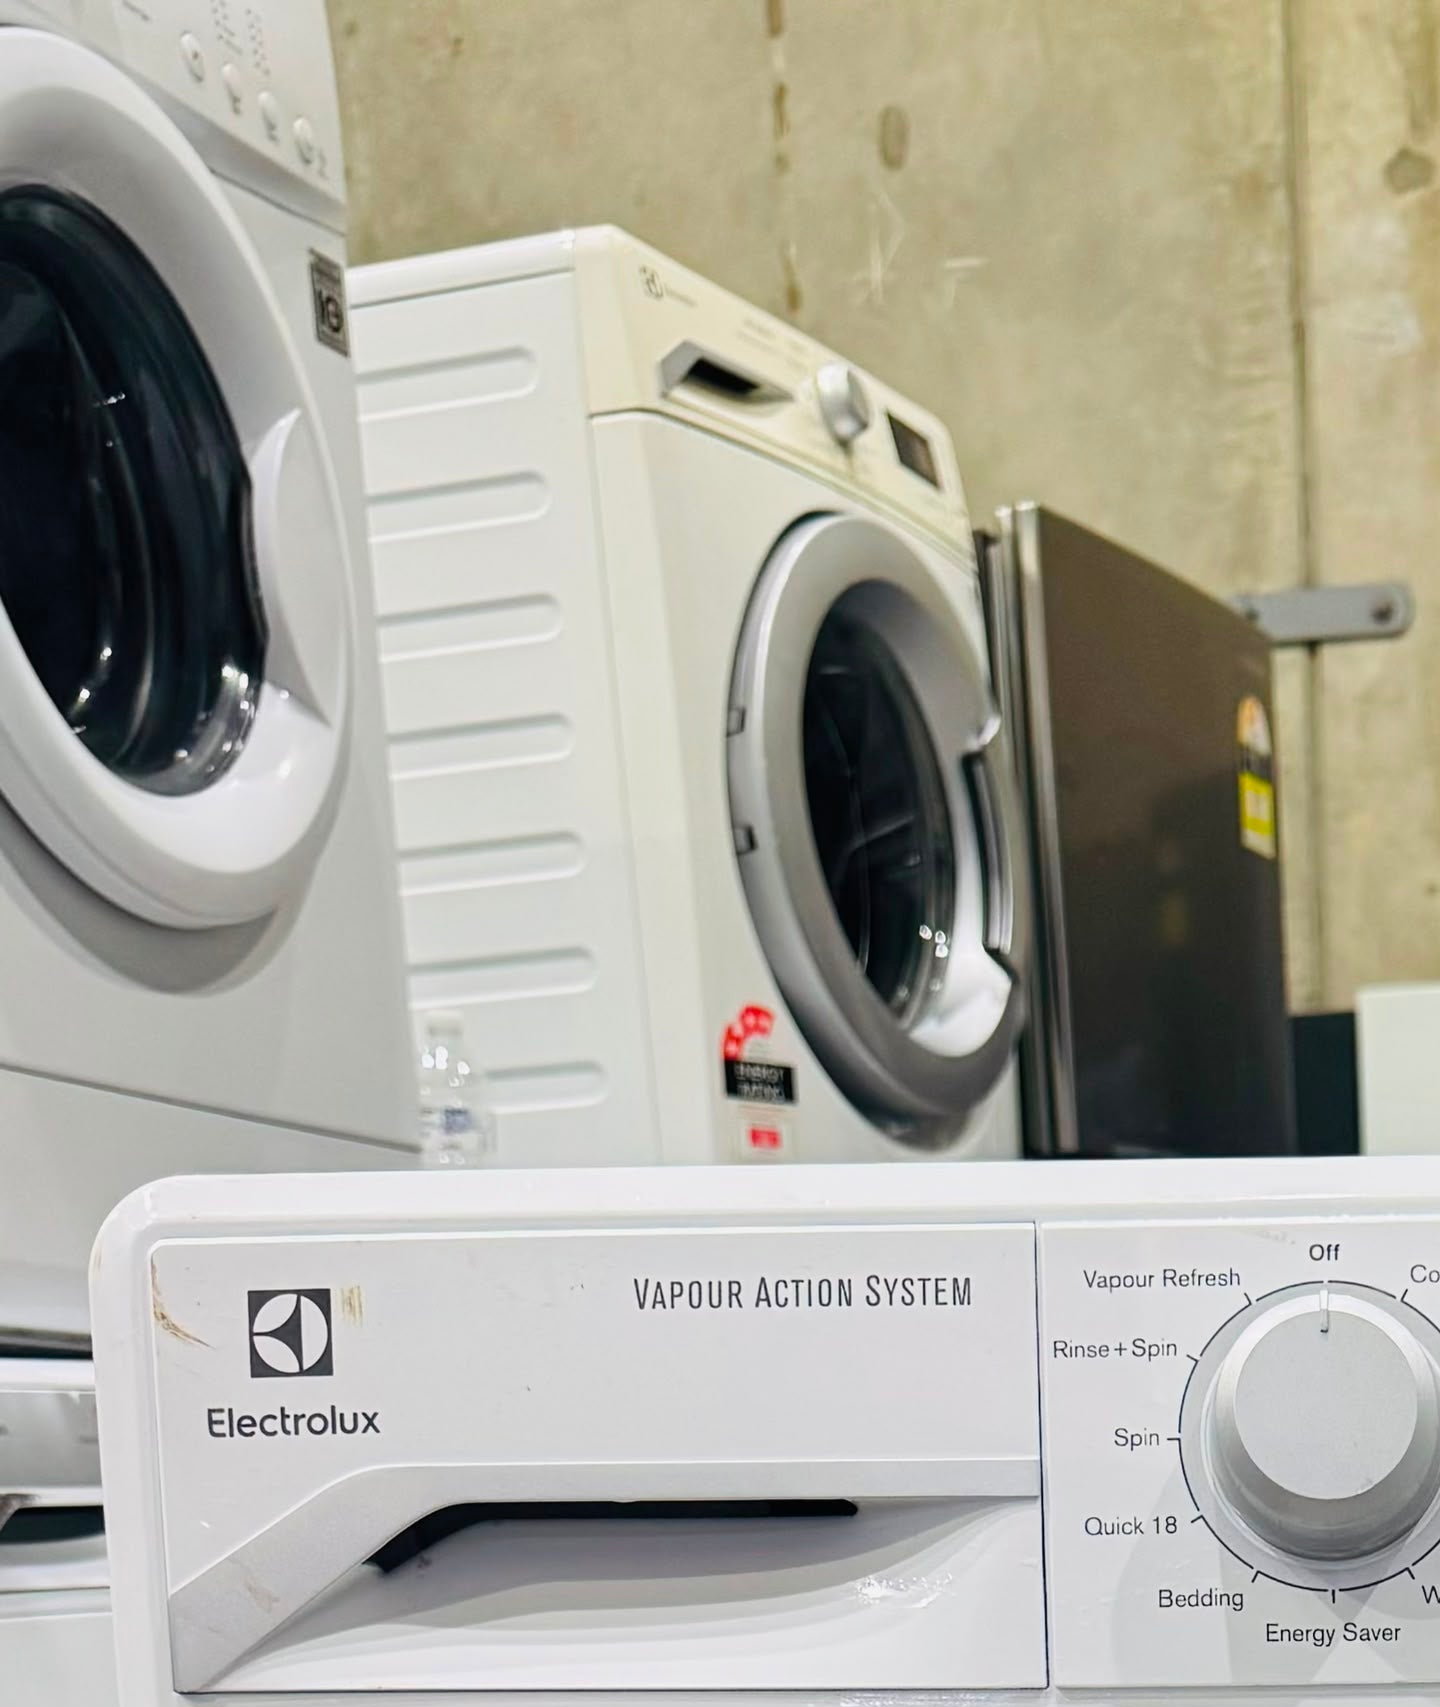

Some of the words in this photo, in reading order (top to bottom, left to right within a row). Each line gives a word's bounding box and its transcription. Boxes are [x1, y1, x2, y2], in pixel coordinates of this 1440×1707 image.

[1308, 1244, 1340, 1263] Off
[1083, 1270, 1154, 1292] Vapour
[1162, 1268, 1241, 1288] Refresh
[207, 1405, 381, 1438] Electrolux
[1114, 1429, 1160, 1451] Spin
[1085, 1517, 1144, 1536] Quick
[1154, 1517, 1178, 1534] 18
[1159, 1589, 1244, 1612] Bedding
[1266, 1624, 1336, 1647] Energy
[1342, 1624, 1401, 1643] Saver
